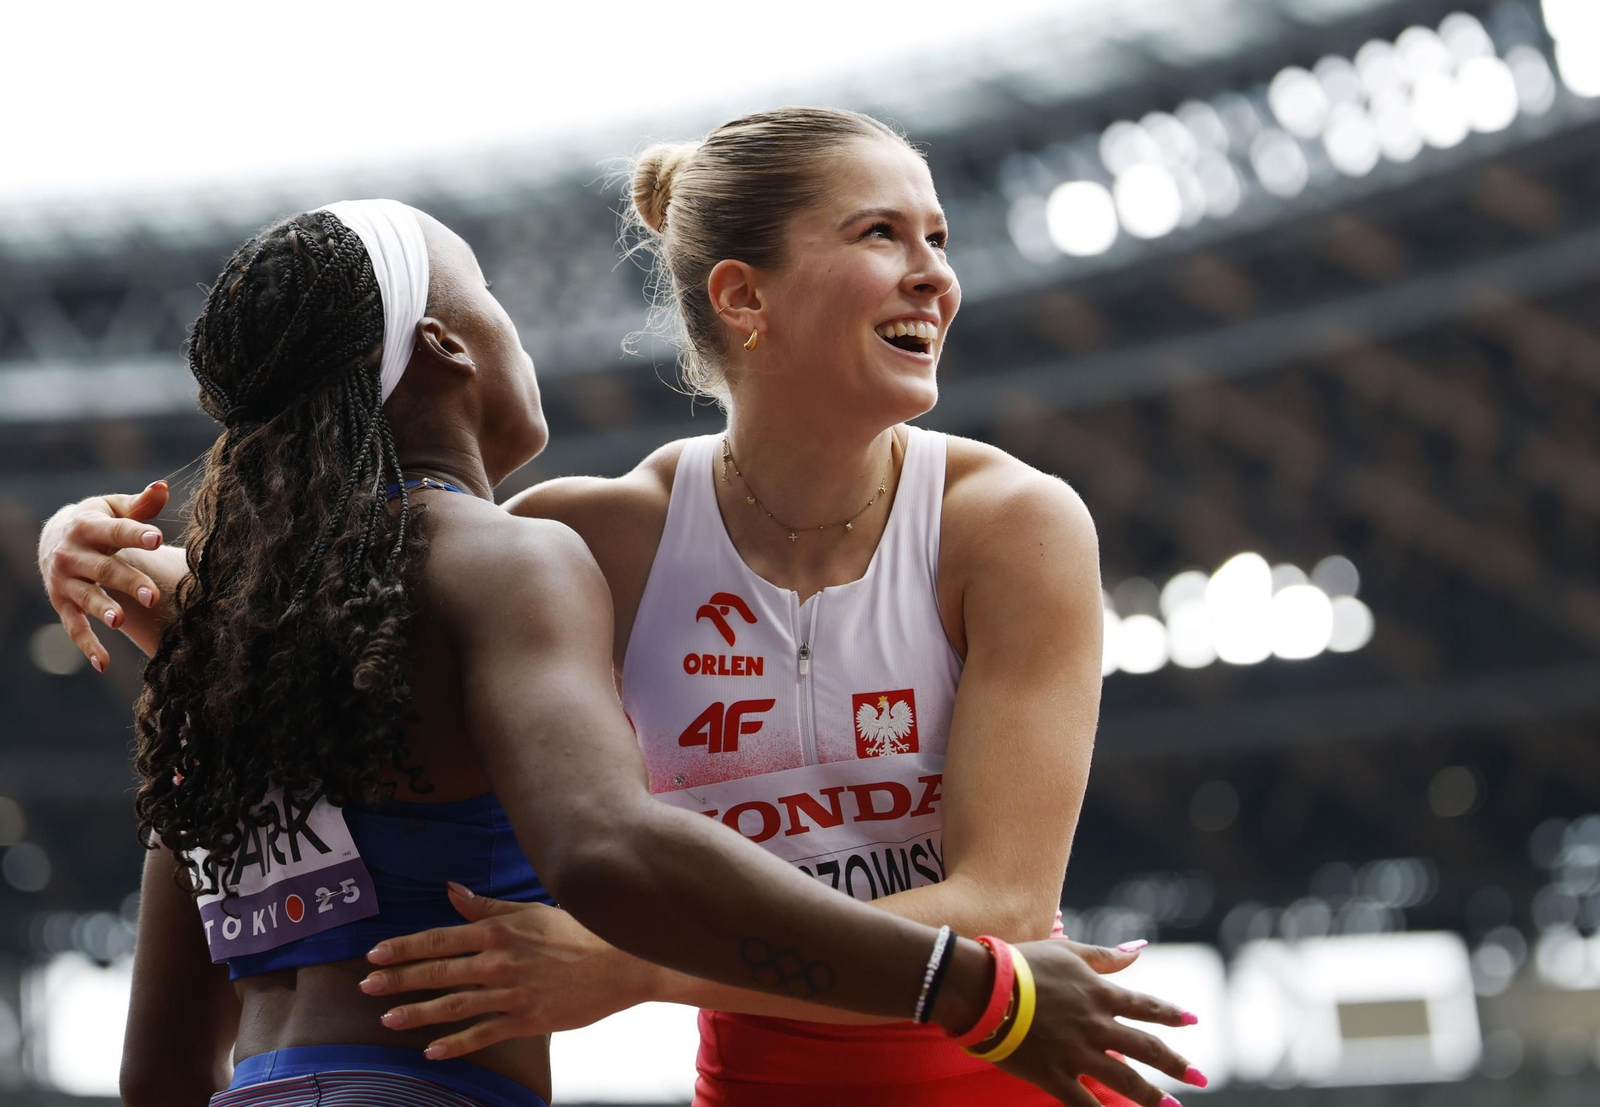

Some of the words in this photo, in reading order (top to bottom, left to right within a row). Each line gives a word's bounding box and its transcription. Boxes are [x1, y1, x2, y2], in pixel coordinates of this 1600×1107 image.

[683, 652, 764, 676] ORLEN
[678, 699, 776, 753] 4F
[699, 773, 943, 844] ONDA
[314, 877, 361, 914] 25
